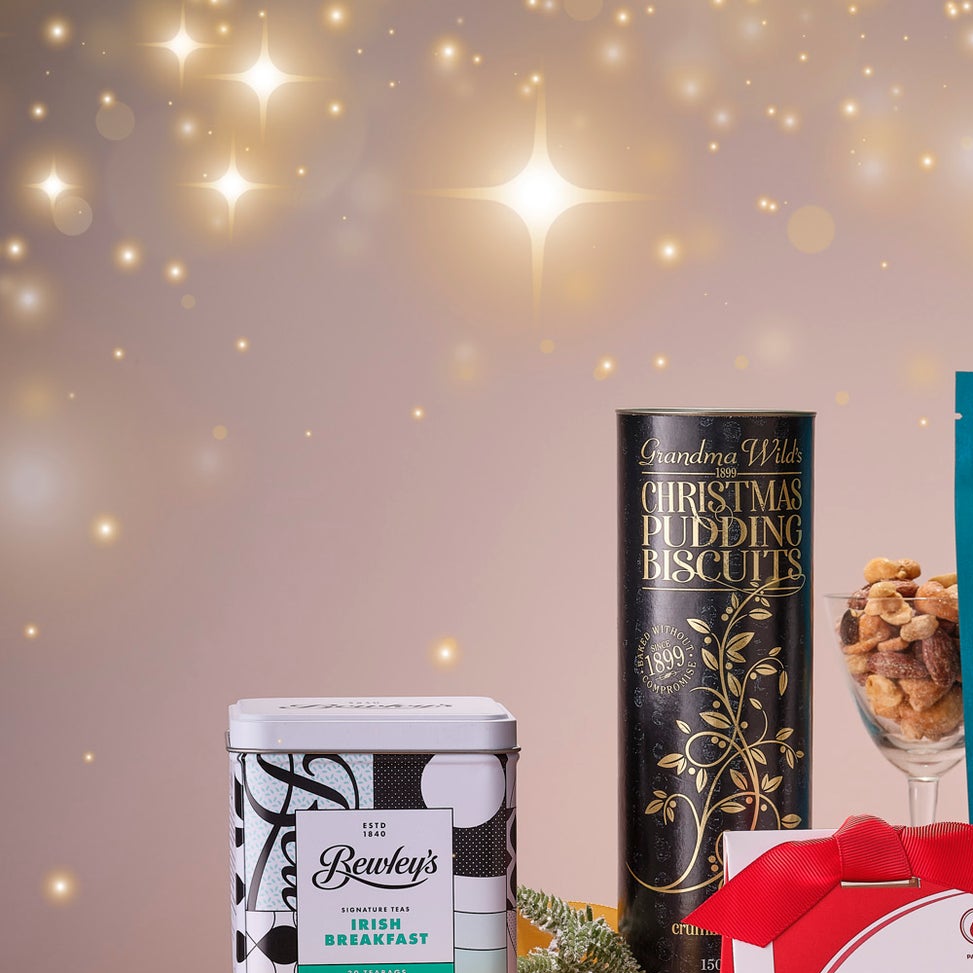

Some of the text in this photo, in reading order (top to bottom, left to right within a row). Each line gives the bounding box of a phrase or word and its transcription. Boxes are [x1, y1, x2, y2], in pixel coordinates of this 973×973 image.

[638, 438, 803, 467] Grandma Wild's
[715, 468, 737, 478] 1899
[641, 478, 803, 514] CHRISTMAS
[641, 514, 802, 547] PUDDING
[641, 548, 803, 584] BISCUITS
[637, 624, 697, 694] BAKED WITHOUT COMPROMISE
[645, 645, 685, 676] 1899
[651, 640, 671, 652] SINCE
[312, 845, 438, 890] Bewley's
[324, 933, 429, 946] BREAKFAST
[351, 918, 401, 930] IRISH
